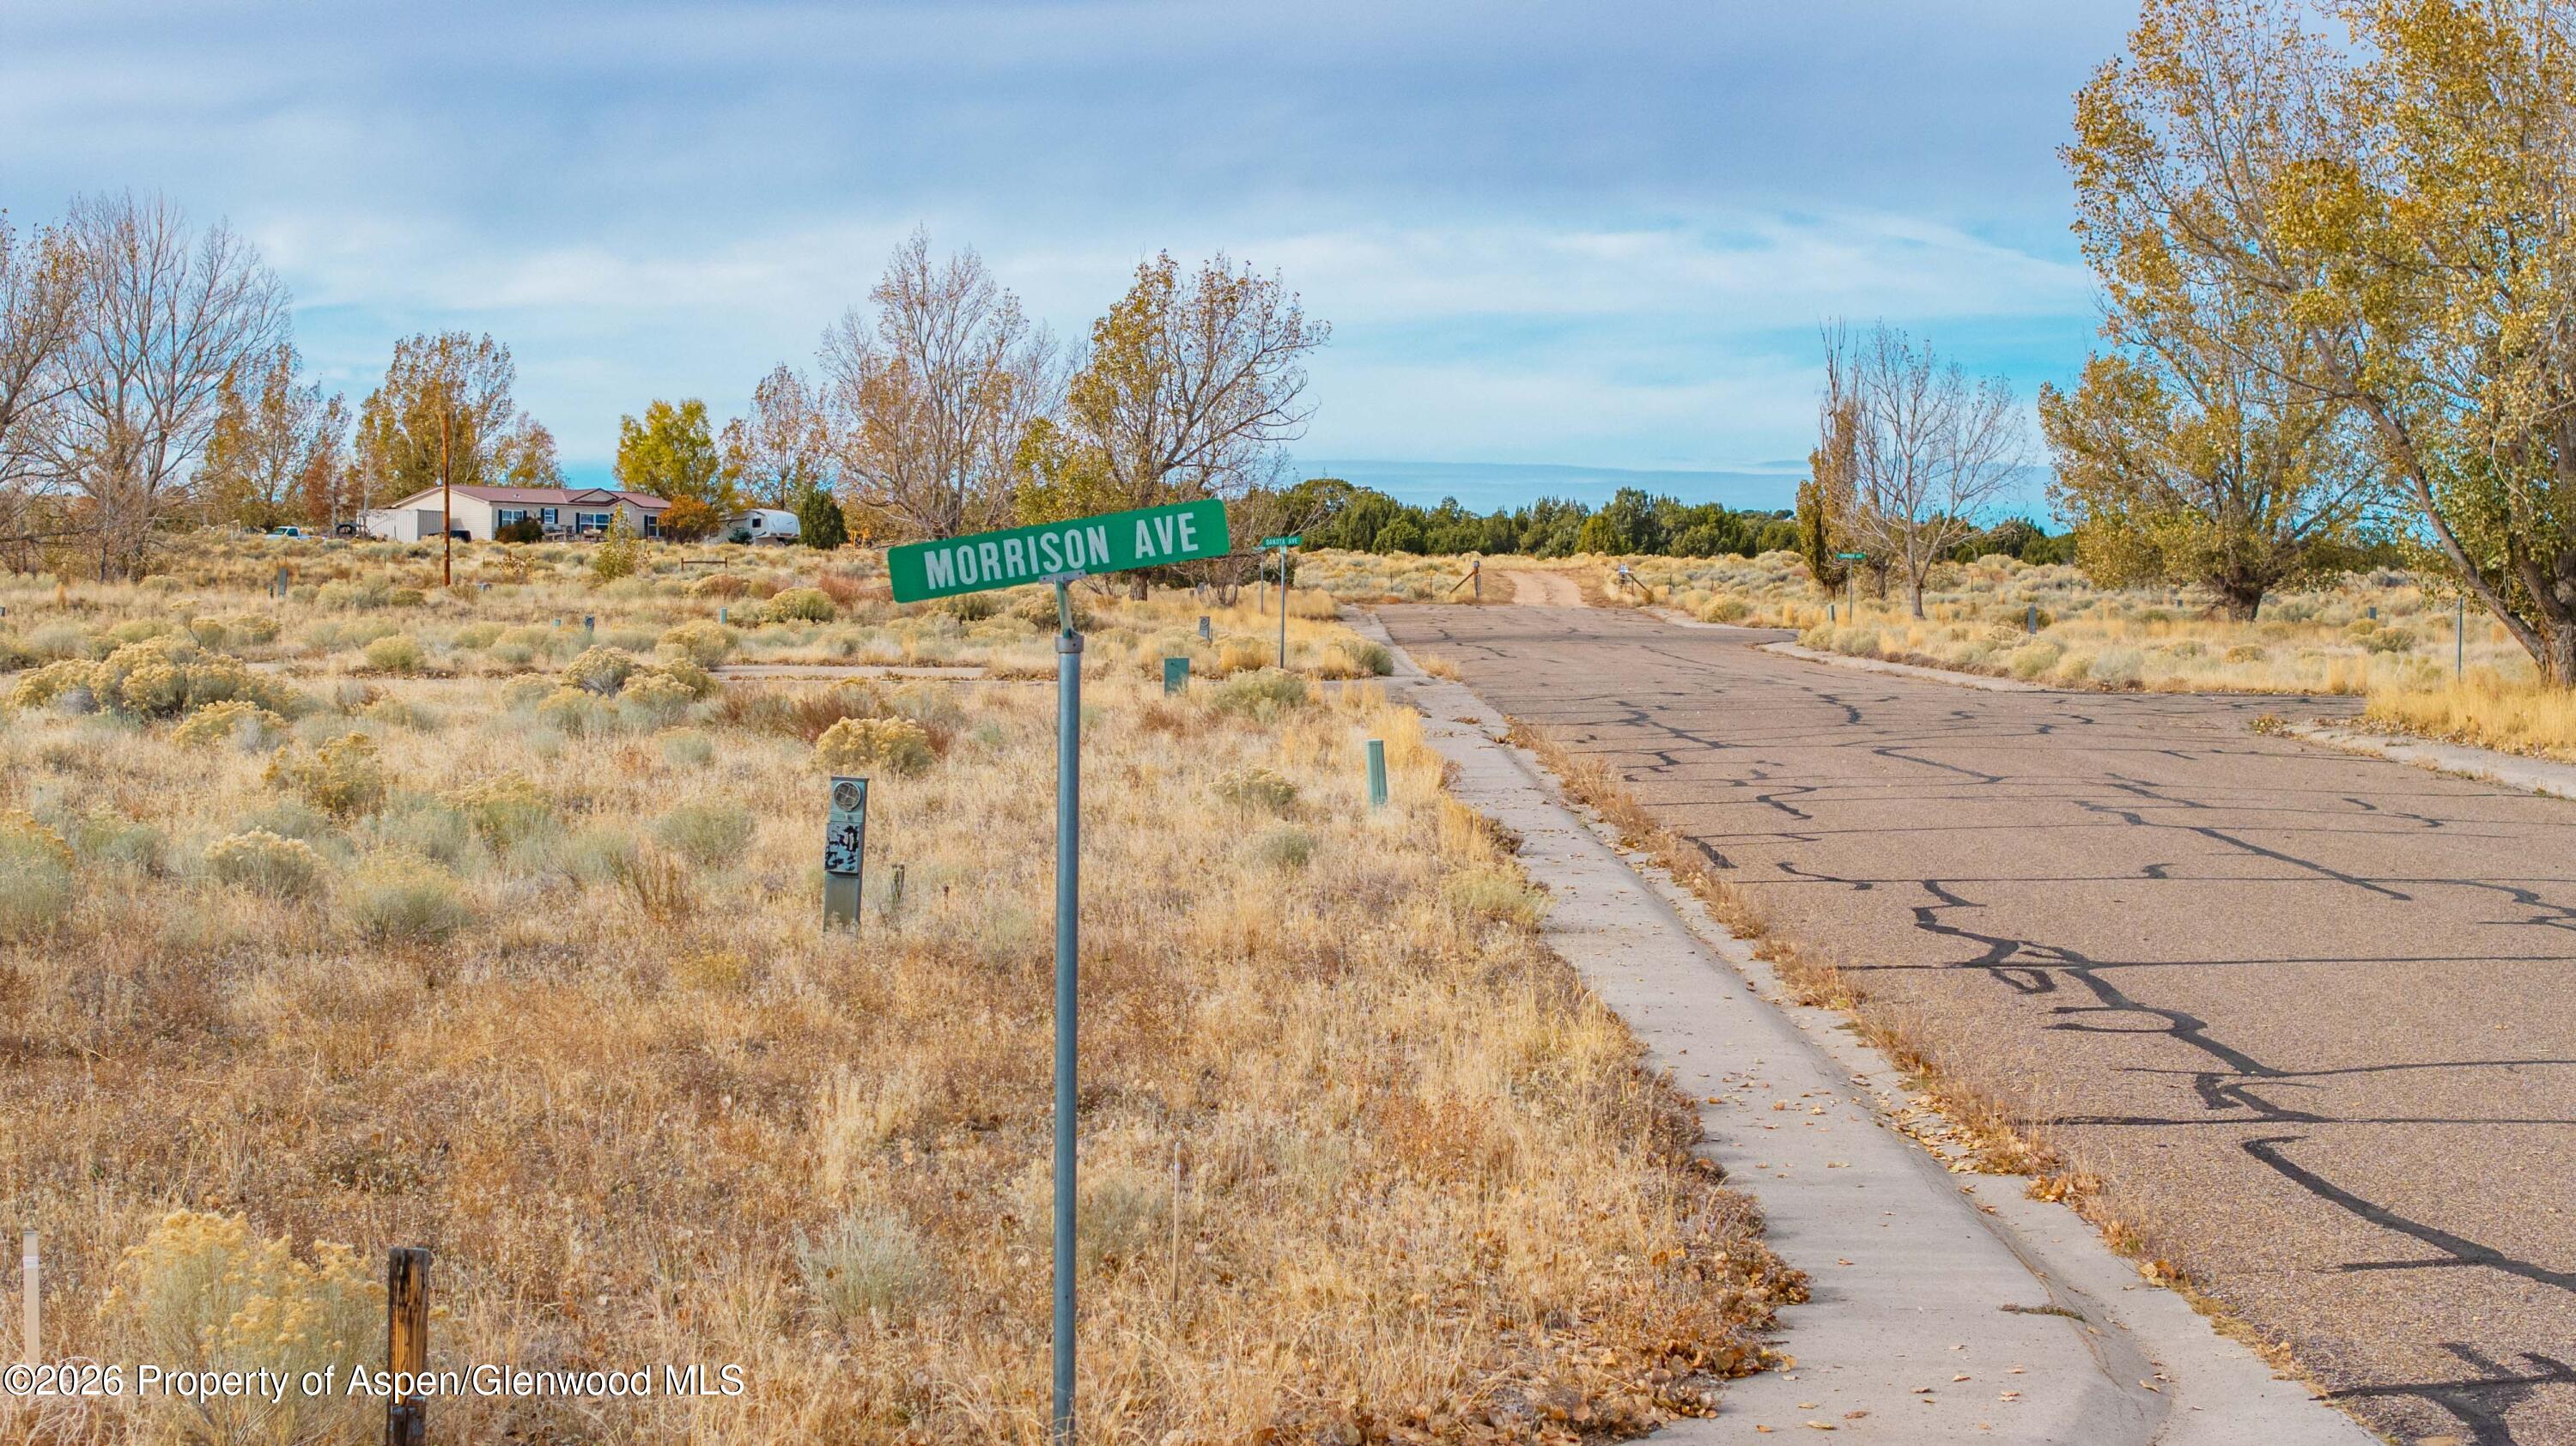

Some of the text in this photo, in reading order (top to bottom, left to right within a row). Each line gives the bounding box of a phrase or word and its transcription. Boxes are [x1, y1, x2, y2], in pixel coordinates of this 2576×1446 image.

[923, 512, 1199, 590] MORRISON AVE
[1266, 537, 1298, 546] DAKOTA AVE
